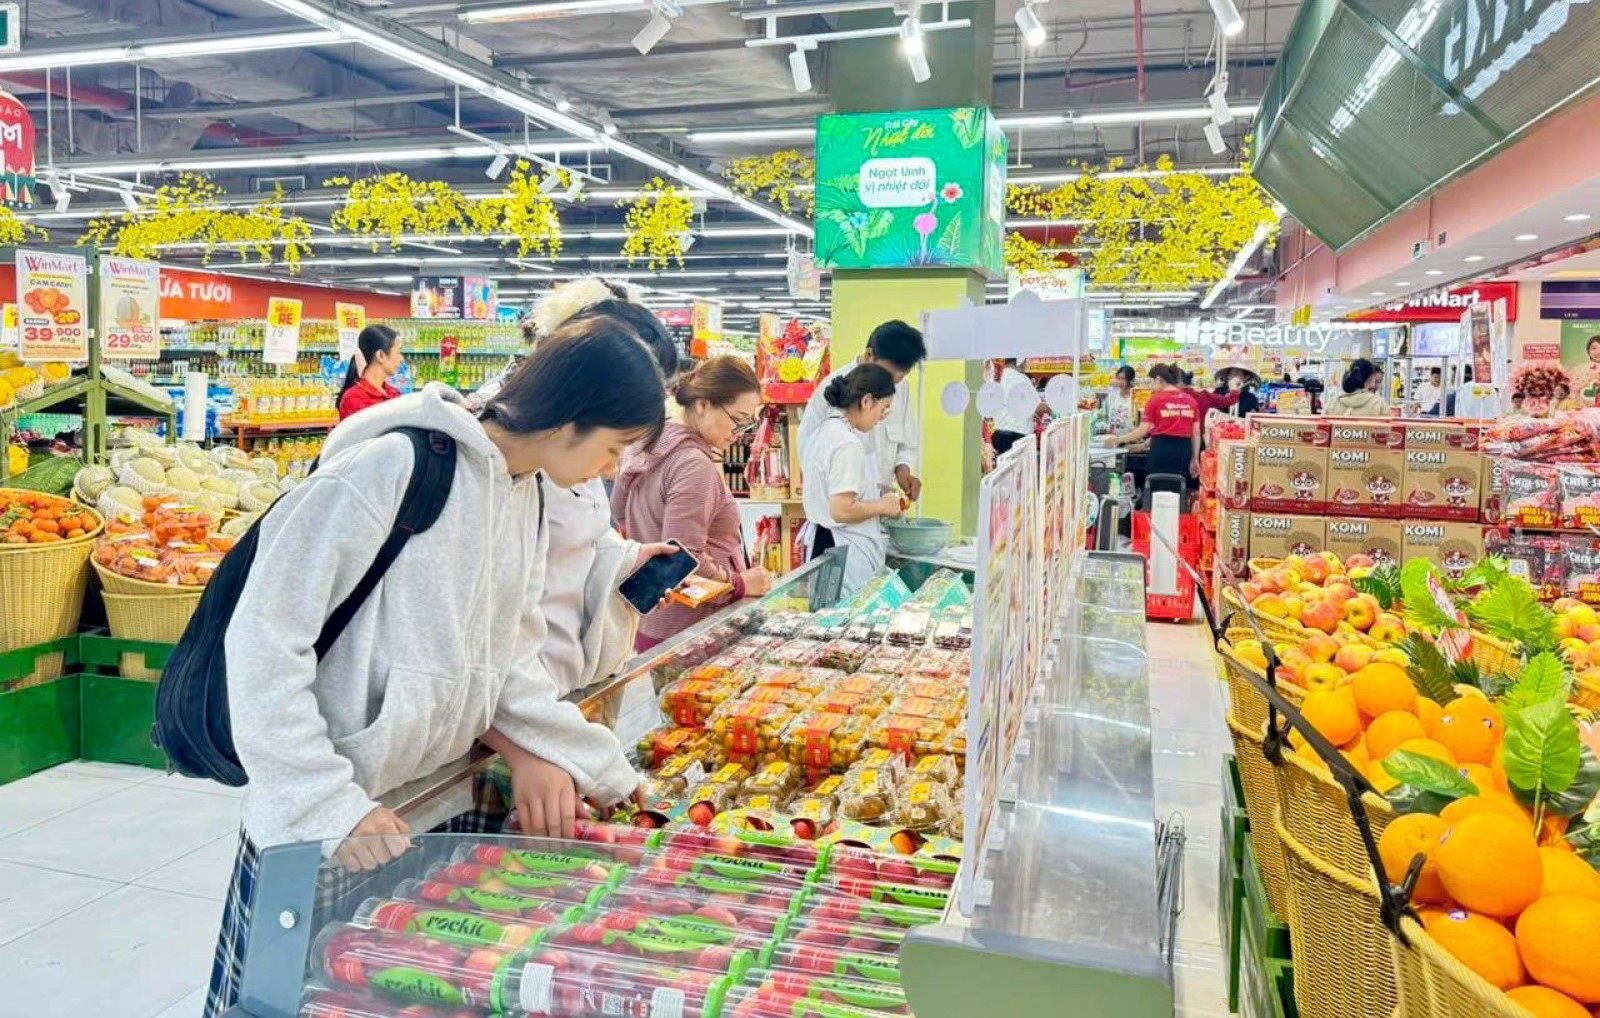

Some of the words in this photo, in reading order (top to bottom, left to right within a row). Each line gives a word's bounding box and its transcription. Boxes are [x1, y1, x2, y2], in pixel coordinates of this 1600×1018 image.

[869, 167, 897, 180] Ngọt
[900, 166, 926, 177] lành
[865, 181, 876, 194] vị
[877, 180, 907, 193] nhiệt
[25, 256, 78, 273] WinMart
[109, 262, 150, 276] WinMart
[160, 274, 184, 298] ỮA
[188, 281, 232, 302] TƯƠI
[1229, 323, 1333, 352] Beauty
[1261, 428, 1295, 438] KOMI
[1334, 429, 1367, 440] KOMI
[1407, 430, 1441, 441] KOMI
[1258, 447, 1295, 459] KOMI
[1331, 451, 1370, 462] KOMI
[1407, 452, 1446, 464] KOMI
[1234, 447, 1246, 479] KOMI
[1230, 514, 1241, 545] KOMI
[1253, 518, 1291, 529] KOMI
[1329, 522, 1369, 534] KOMI
[1405, 526, 1445, 537] KOMI
[426, 915, 486, 937] rockit
[384, 979, 444, 999] rockit
